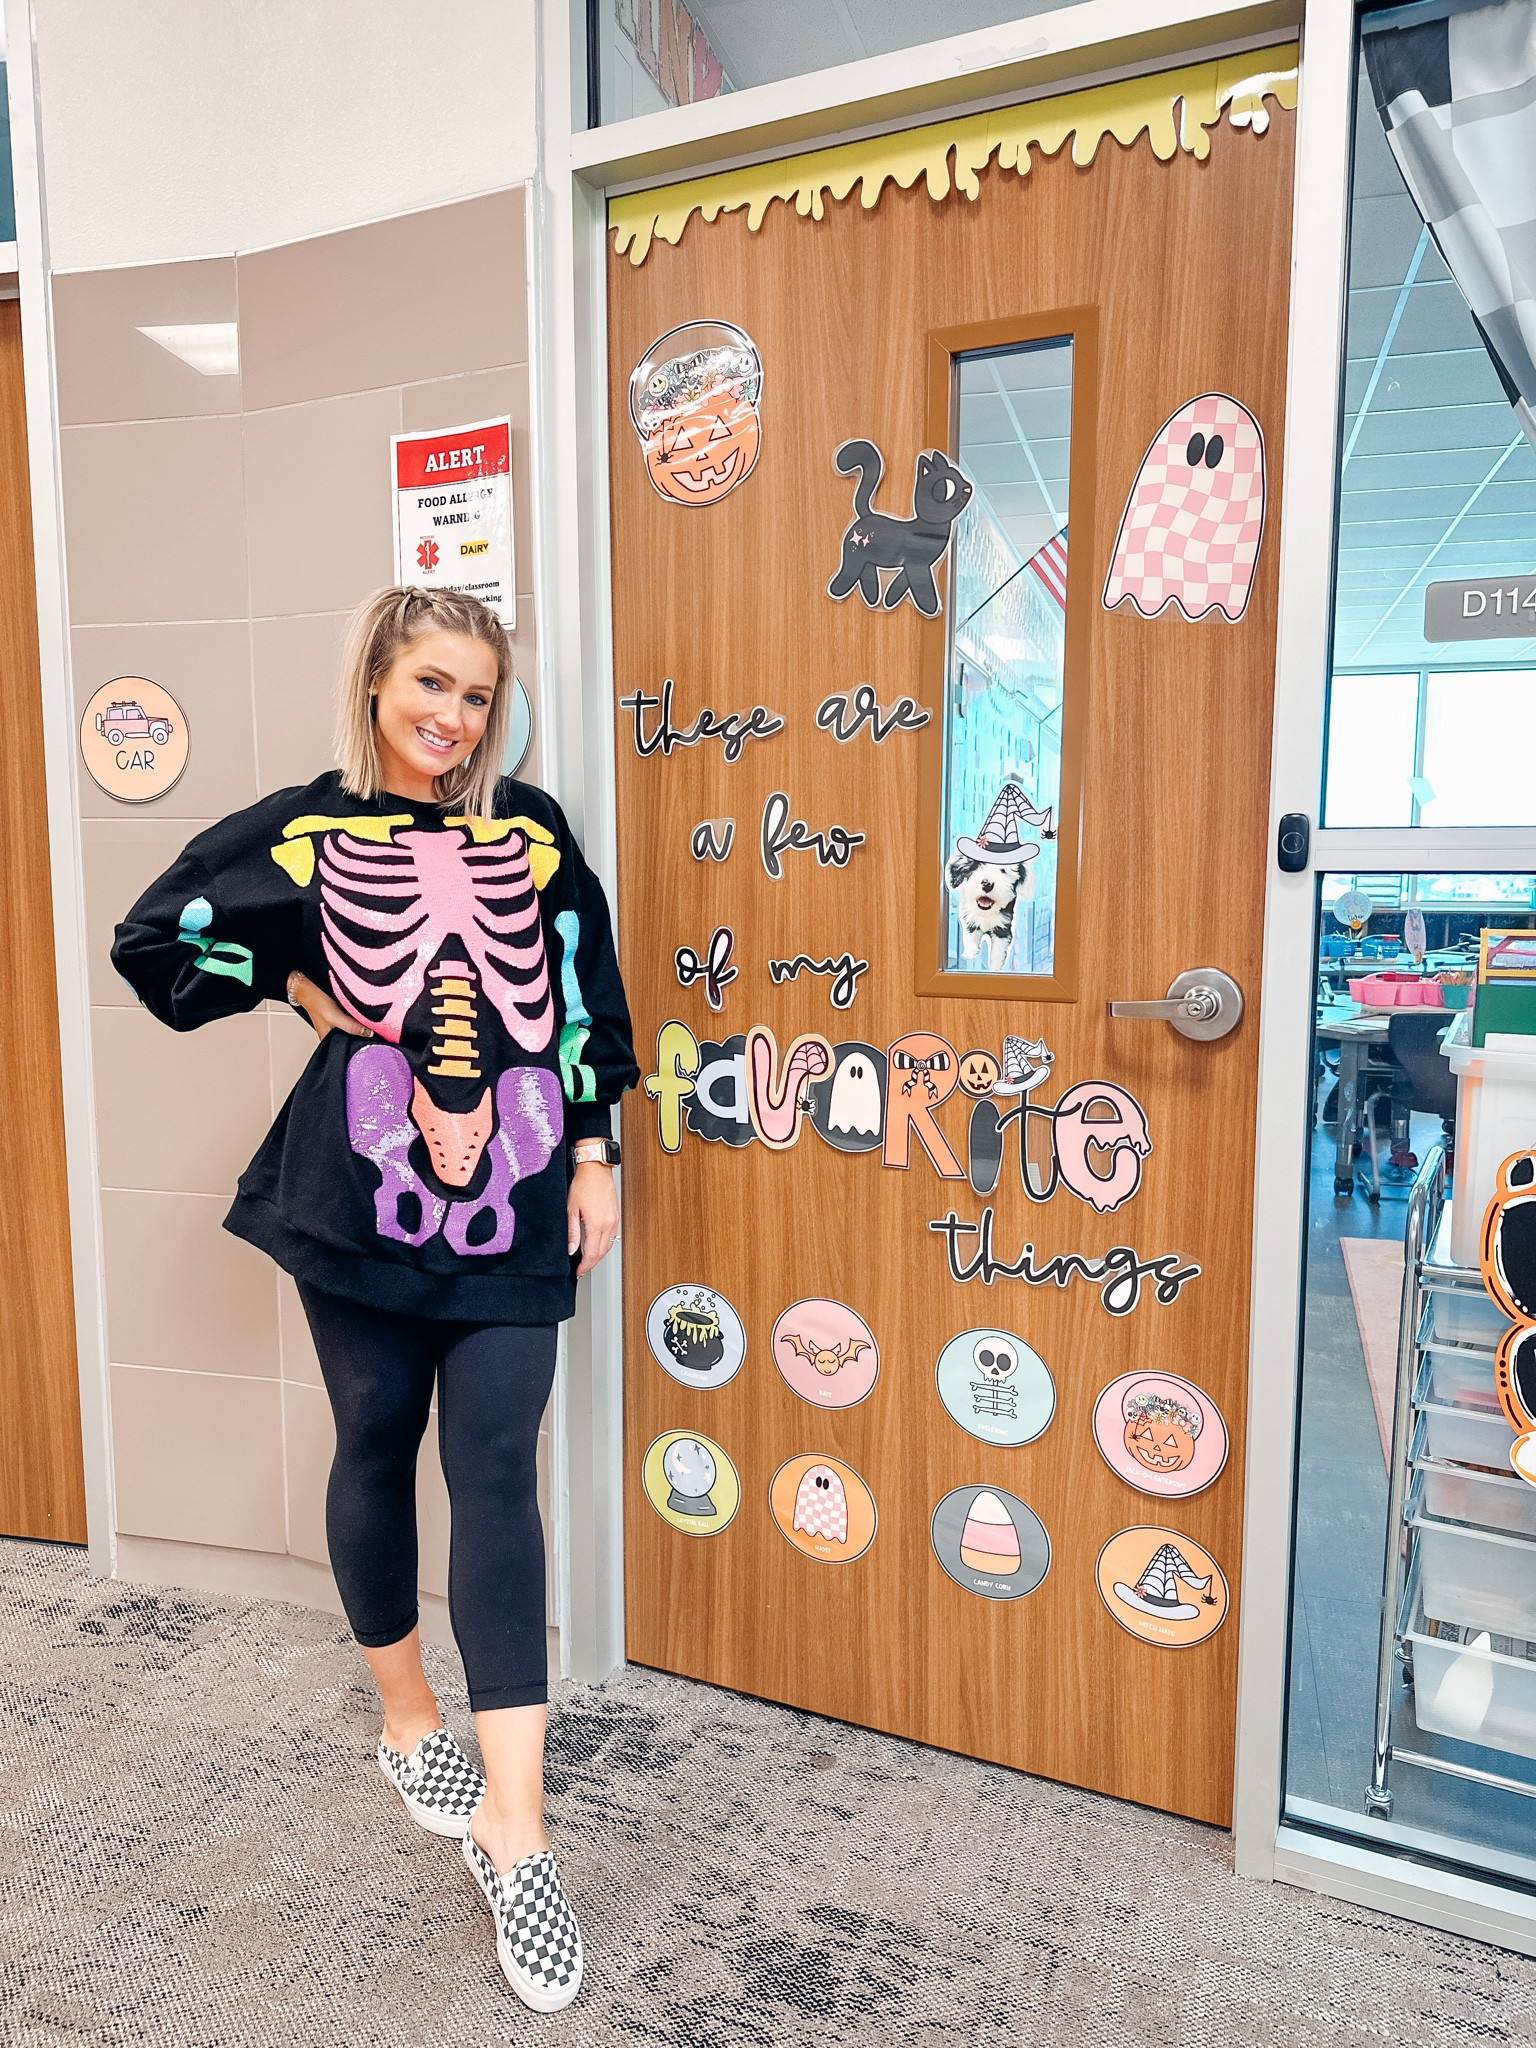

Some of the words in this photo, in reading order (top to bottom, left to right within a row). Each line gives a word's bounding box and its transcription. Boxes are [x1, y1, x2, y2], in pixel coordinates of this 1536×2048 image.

[424, 445, 485, 473] ALERT
[417, 496, 447, 509] FOOD
[449, 488, 493, 505] ALLGY
[432, 510, 481, 527] WARNIG
[1463, 587, 1536, 617] D114
[621, 679, 783, 762] these
[816, 685, 930, 743] are
[115, 750, 155, 770] CAR
[692, 821, 735, 861] a
[761, 792, 865, 879] few
[675, 926, 738, 1007] of
[769, 953, 867, 1008] my
[930, 1209, 1201, 1316] things
[973, 1578, 994, 1588] CANDY
[994, 1582, 1012, 1592] CORN
[1138, 1620, 1158, 1632] WITCH
